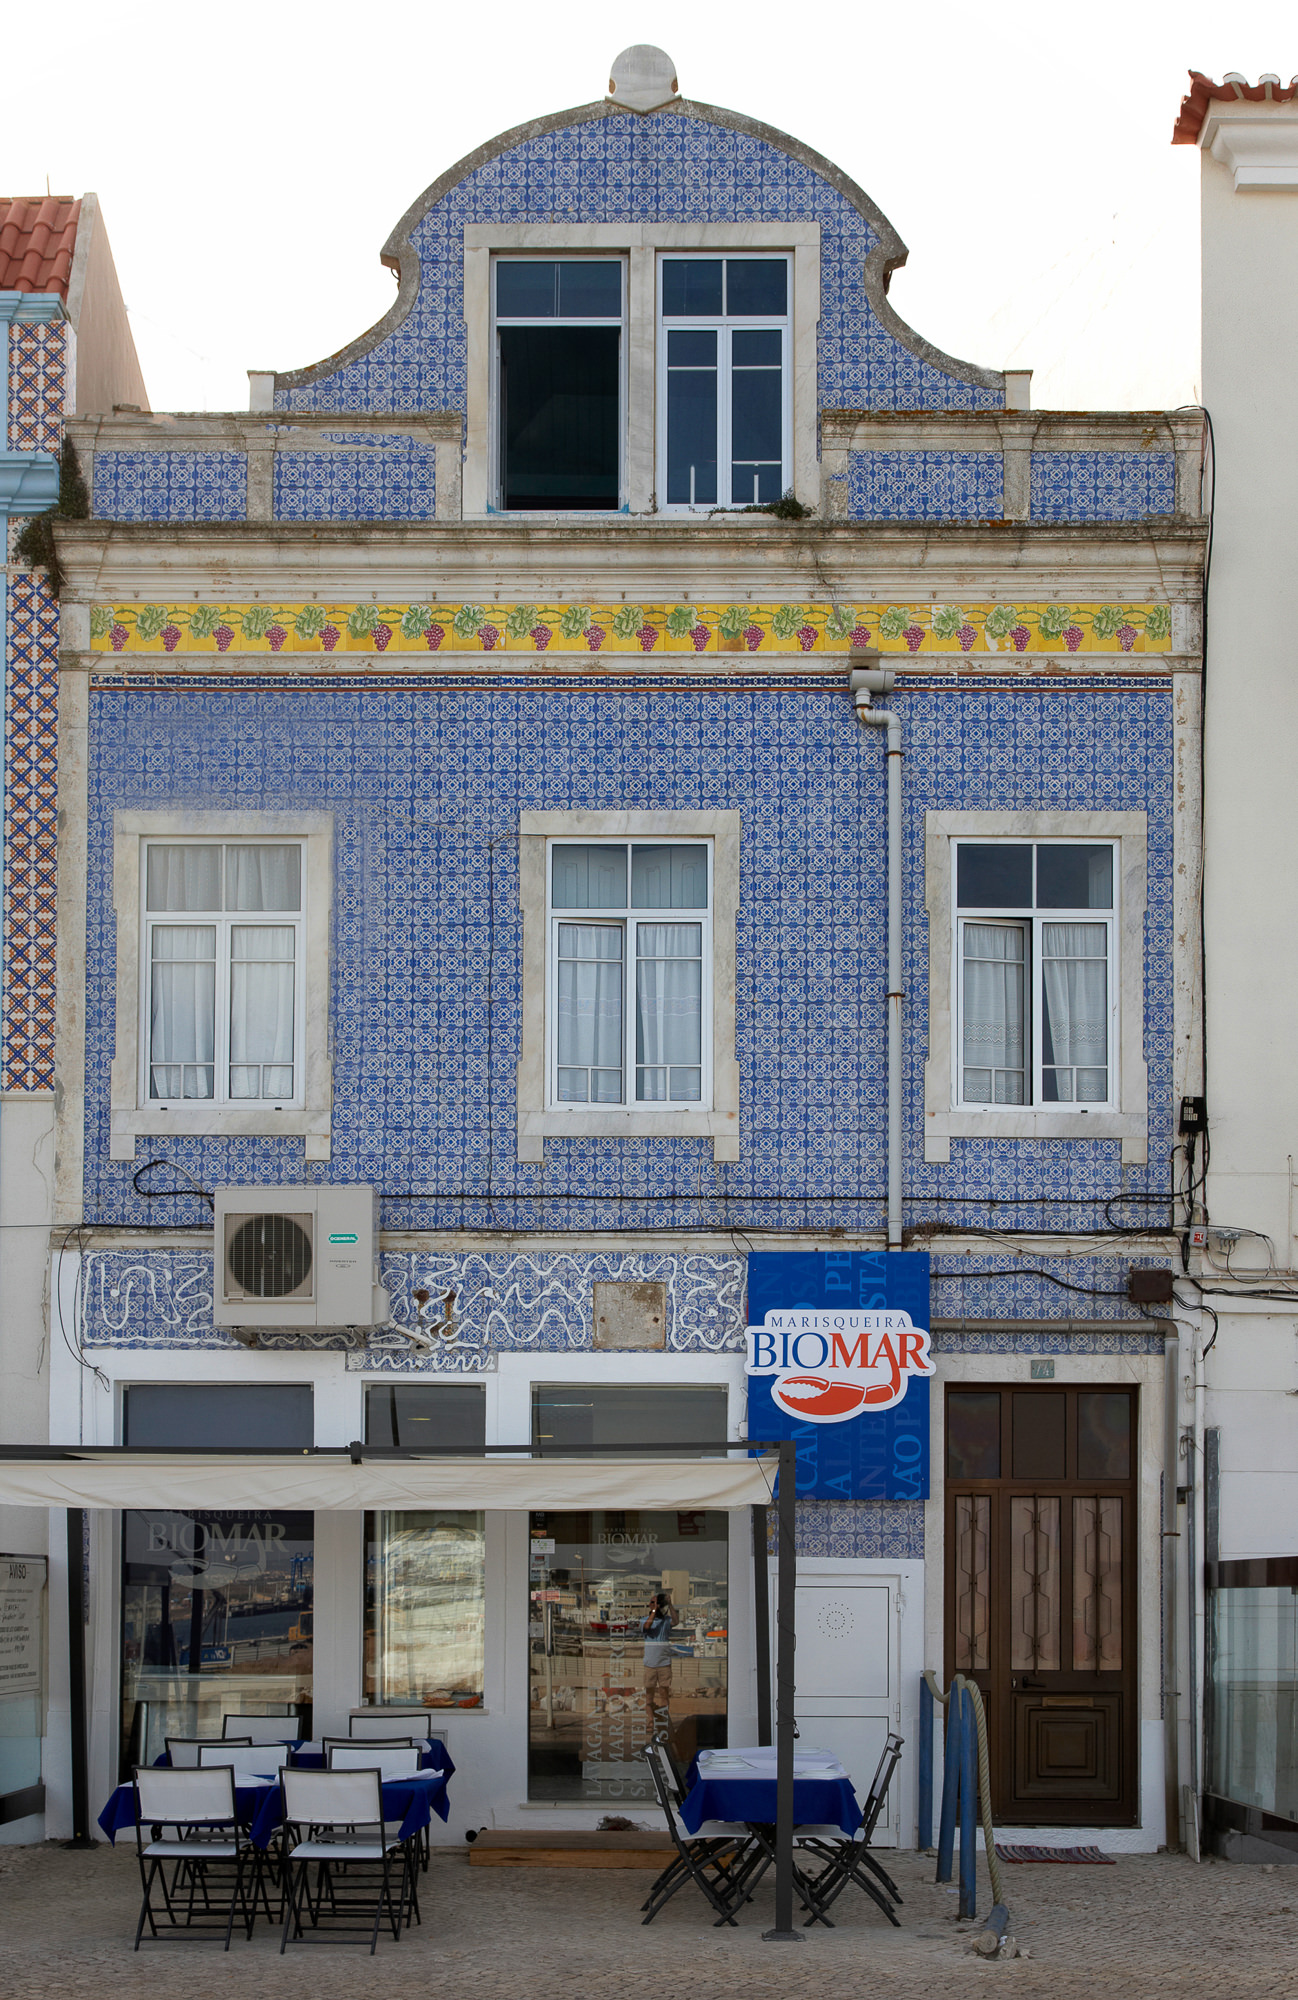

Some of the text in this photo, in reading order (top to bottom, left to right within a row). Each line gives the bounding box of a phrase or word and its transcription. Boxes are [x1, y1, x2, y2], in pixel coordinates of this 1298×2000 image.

[771, 1317, 907, 1330] MARISQUEIRA
[751, 1332, 929, 1370] BIOMAR
[146, 1522, 289, 1552] BIOMAR
[597, 1533, 659, 1547] BIOMAR
[9, 1564, 26, 1579] AVISO
[586, 1679, 602, 1796] LAVAGANTE
